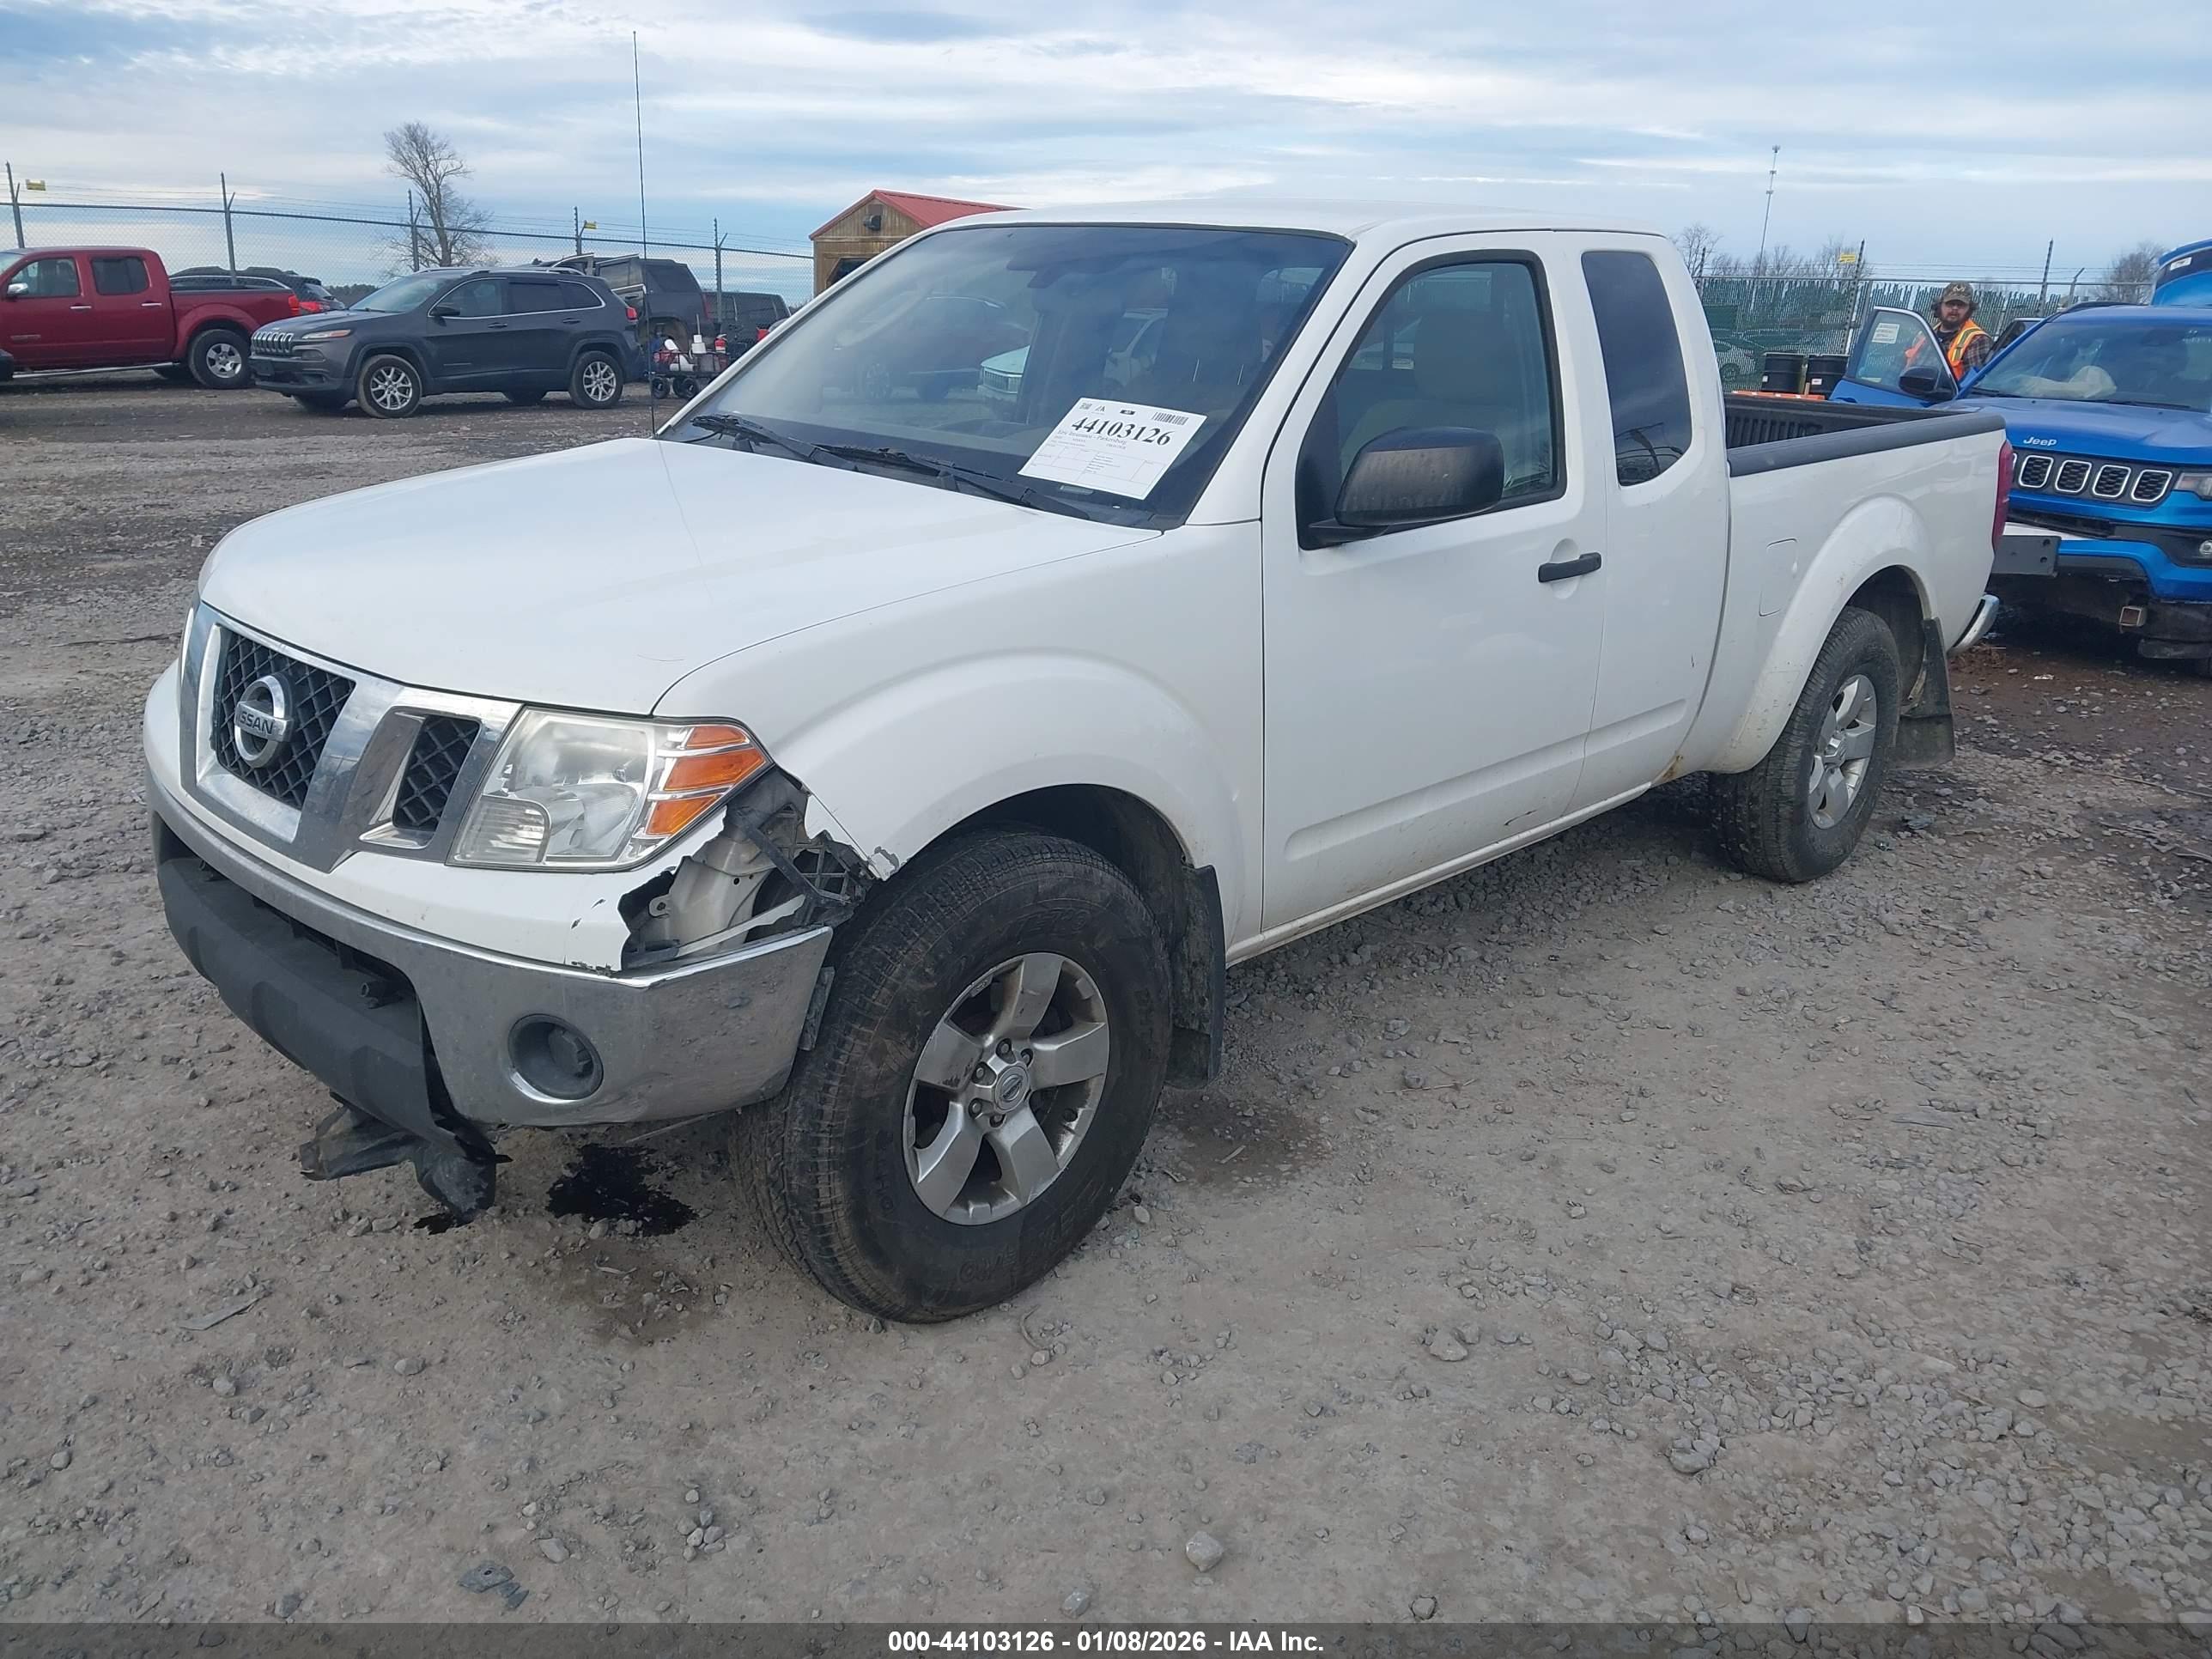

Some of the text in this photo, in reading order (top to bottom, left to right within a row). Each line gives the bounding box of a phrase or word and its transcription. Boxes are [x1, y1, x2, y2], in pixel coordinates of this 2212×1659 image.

[1071, 416, 1176, 446] 44103126
[2023, 436, 2057, 447] Jeep
[236, 709, 275, 734] SSAN
